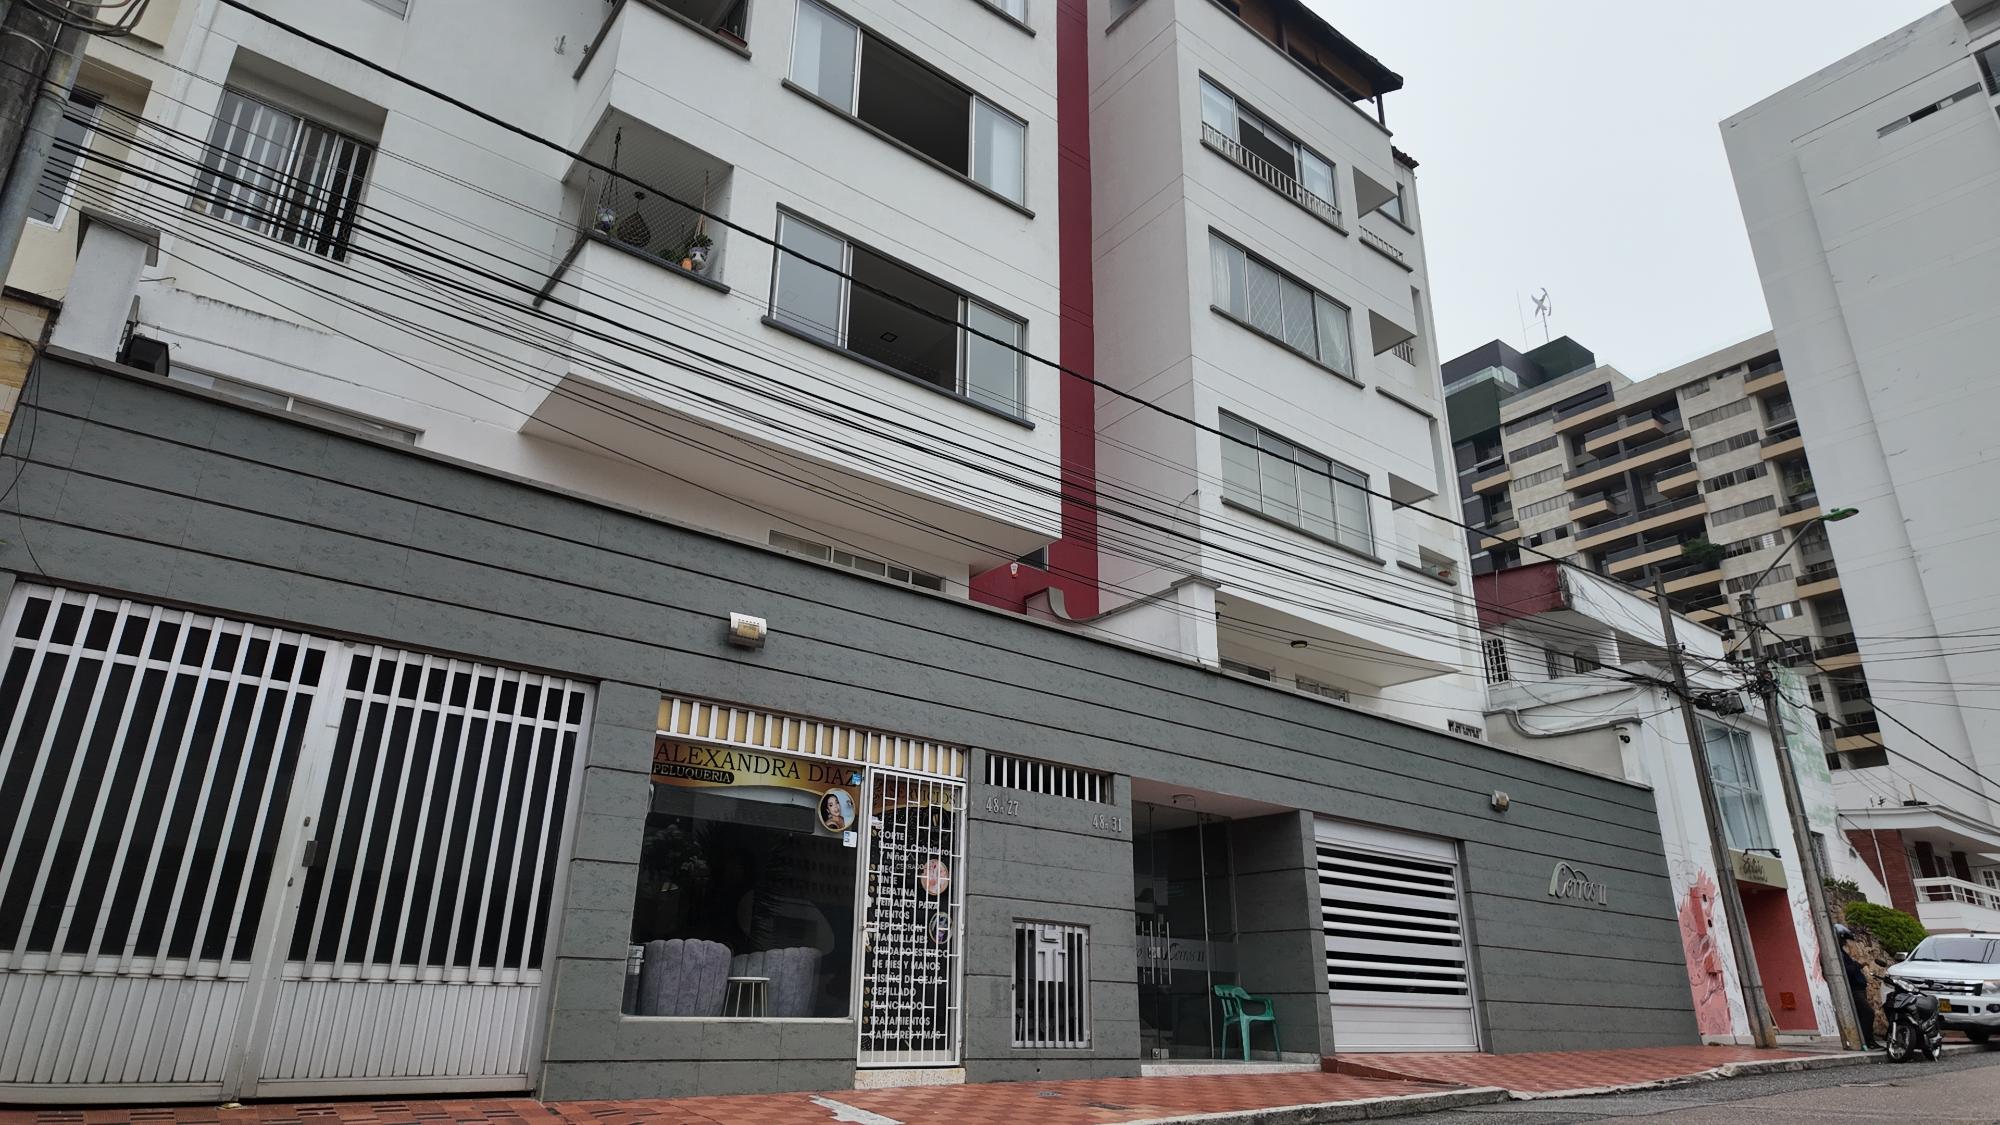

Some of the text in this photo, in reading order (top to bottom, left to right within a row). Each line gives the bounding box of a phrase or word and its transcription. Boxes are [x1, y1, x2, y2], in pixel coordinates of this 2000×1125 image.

[653, 742, 857, 787] ALEXANDRA DIAZ
[653, 763, 731, 783] PELUQUERIA
[877, 831, 905, 841] CORTE
[1549, 861, 1597, 901] Cerros
[874, 909, 910, 920] EVENTOS
[903, 960, 910, 970] Y
[911, 960, 941, 971] MANOS
[870, 987, 917, 997] CEPILLADO
[869, 1015, 931, 1026] TRATAMIENTOS
